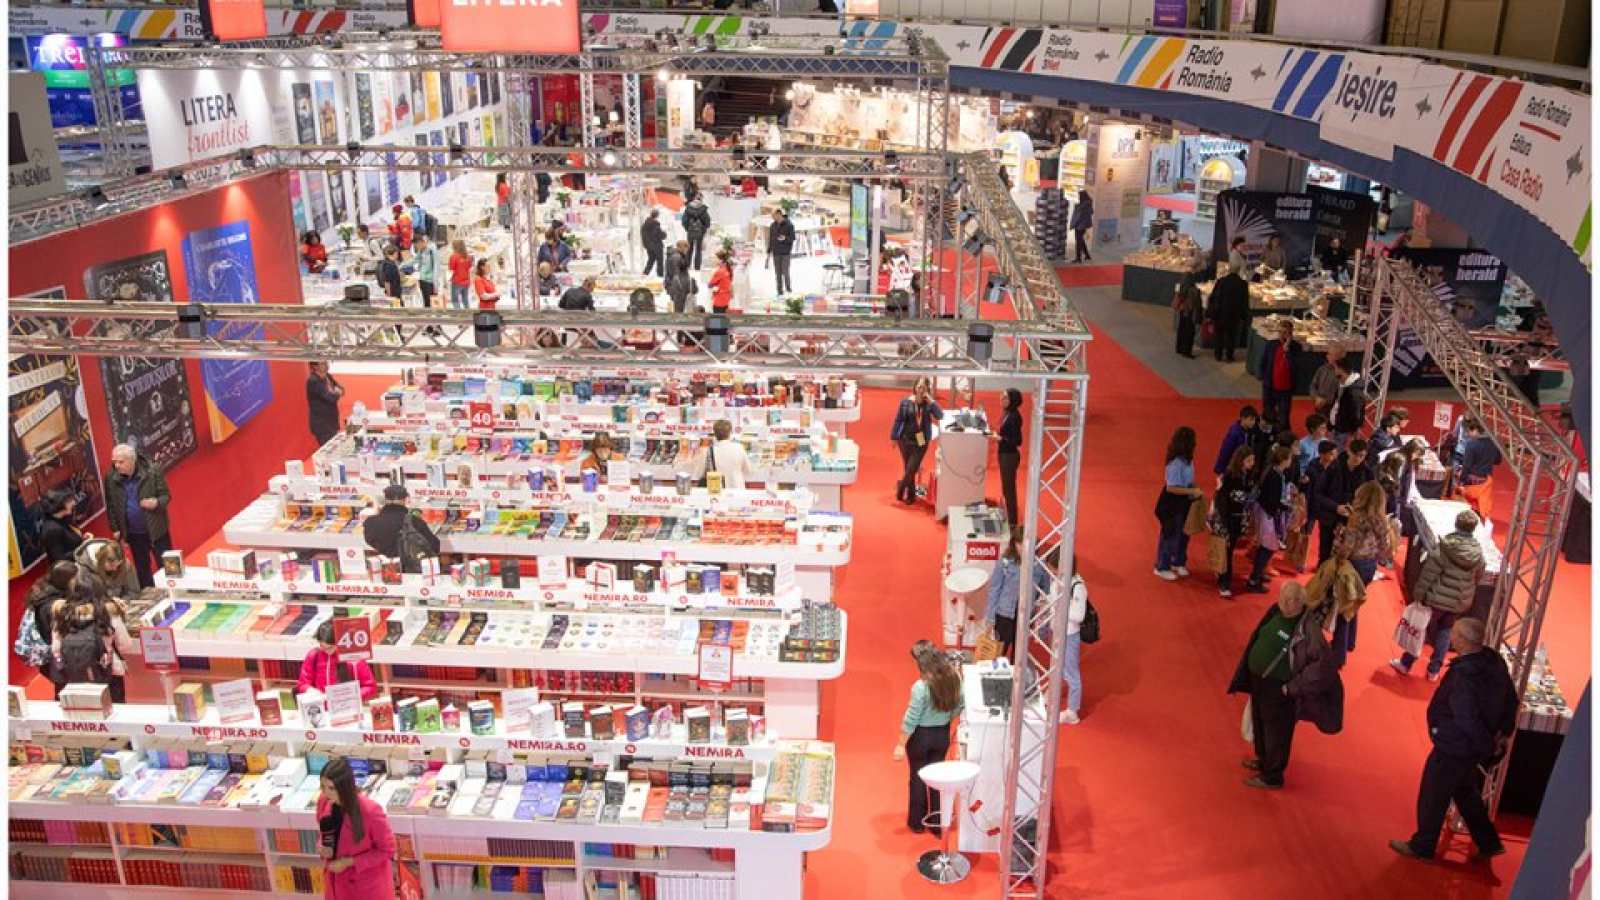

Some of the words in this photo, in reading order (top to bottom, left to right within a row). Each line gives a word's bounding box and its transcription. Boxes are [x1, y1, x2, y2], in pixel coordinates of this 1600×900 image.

[1049, 34, 1072, 46] Radio
[1044, 47, 1080, 60] România
[1186, 44, 1225, 66] Radio
[1177, 67, 1233, 93] România
[181, 92, 238, 126] LITERA
[187, 118, 250, 162] frontlist
[1501, 158, 1521, 188] Casa
[1520, 167, 1543, 201] Radio
[1456, 267, 1499, 280] herald
[472, 412, 491, 426] 40
[320, 485, 357, 494] NEMIRA
[415, 489, 468, 498] NEMIRA.RO
[213, 581, 258, 590] NEMIRA
[326, 585, 388, 594] NEMIRA.RO
[467, 589, 514, 599] NEMIRA
[583, 593, 648, 602] NEMIRA.RO
[727, 598, 776, 607] NEMIRA
[337, 629, 369, 649] 40
[51, 721, 109, 733] NEMIRA
[362, 733, 421, 744] NEMIRA
[507, 740, 586, 751] NEMIRA.RO
[684, 746, 745, 758] NEMIRA
